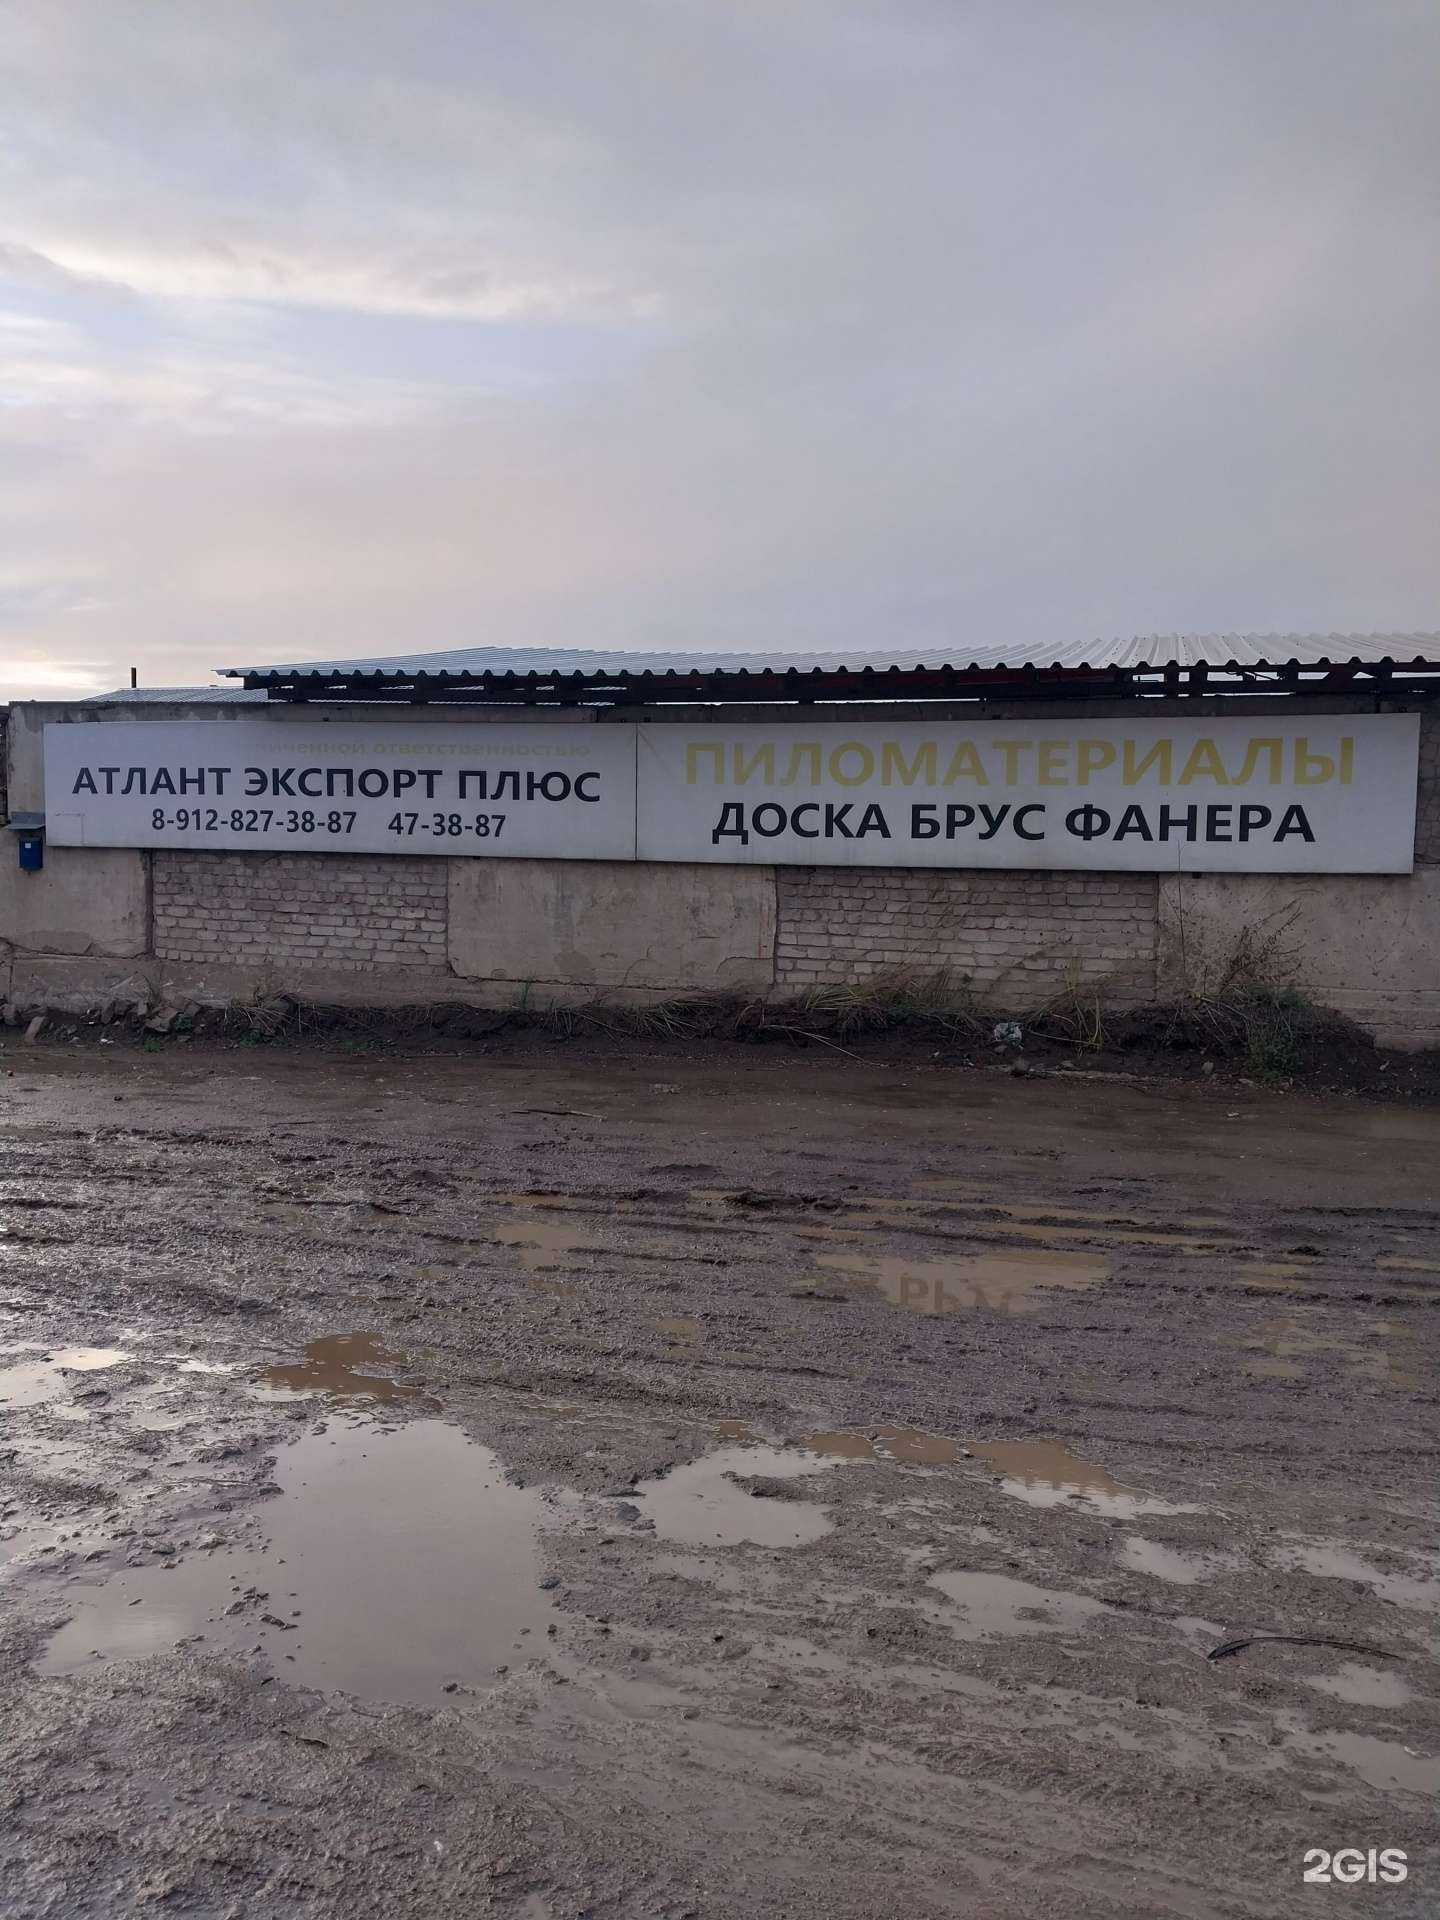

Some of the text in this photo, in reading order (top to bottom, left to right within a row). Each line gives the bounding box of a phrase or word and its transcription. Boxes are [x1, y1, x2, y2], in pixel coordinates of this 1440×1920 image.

[686, 737, 1355, 786] ПИЛОМАТЕРИАЛЫ
[72, 767, 602, 803] АТЛАНТ ЭКСПОРТ ПЛЮС
[152, 809, 506, 838] 8-912-827-38-87 47-38-87
[712, 802, 1316, 845] ДОСКА БРУС ФАНЕРА
